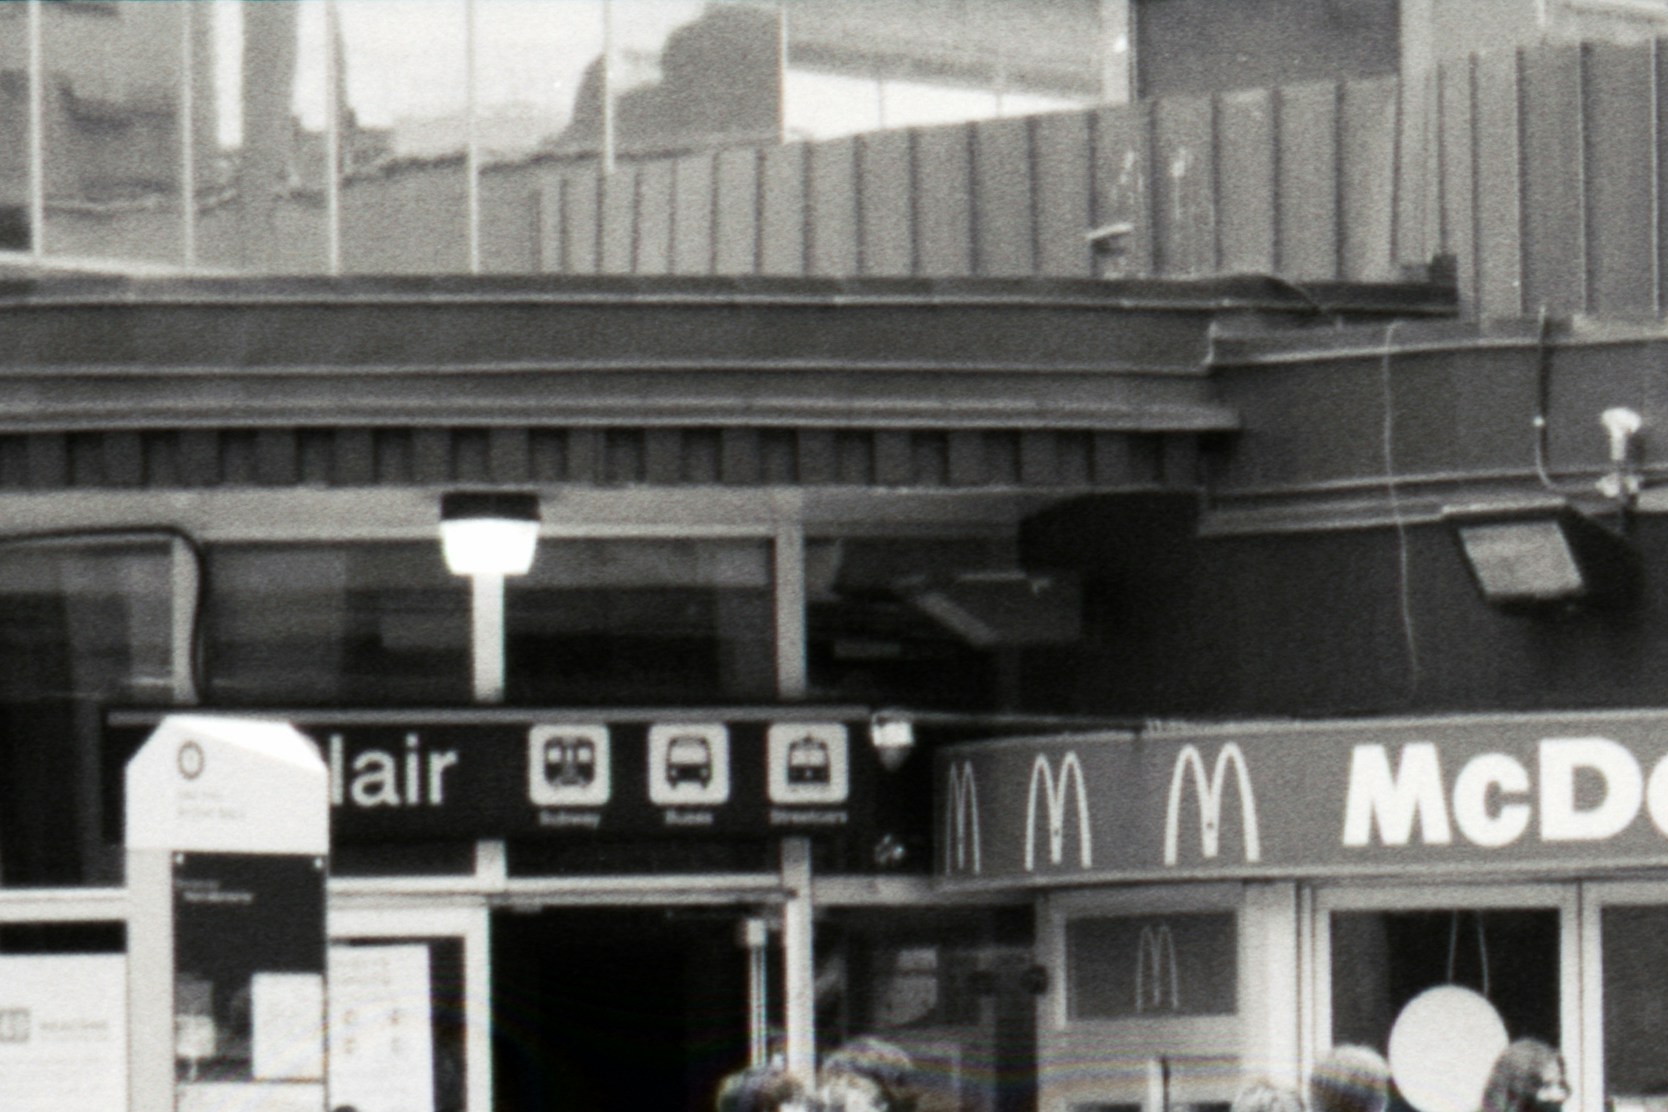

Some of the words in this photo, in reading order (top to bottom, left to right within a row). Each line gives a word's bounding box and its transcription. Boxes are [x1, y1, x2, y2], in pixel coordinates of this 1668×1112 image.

[328, 732, 458, 806] lair
[538, 810, 601, 829] Subway
[664, 808, 714, 826] Buses
[769, 808, 848, 826] Streetcars
